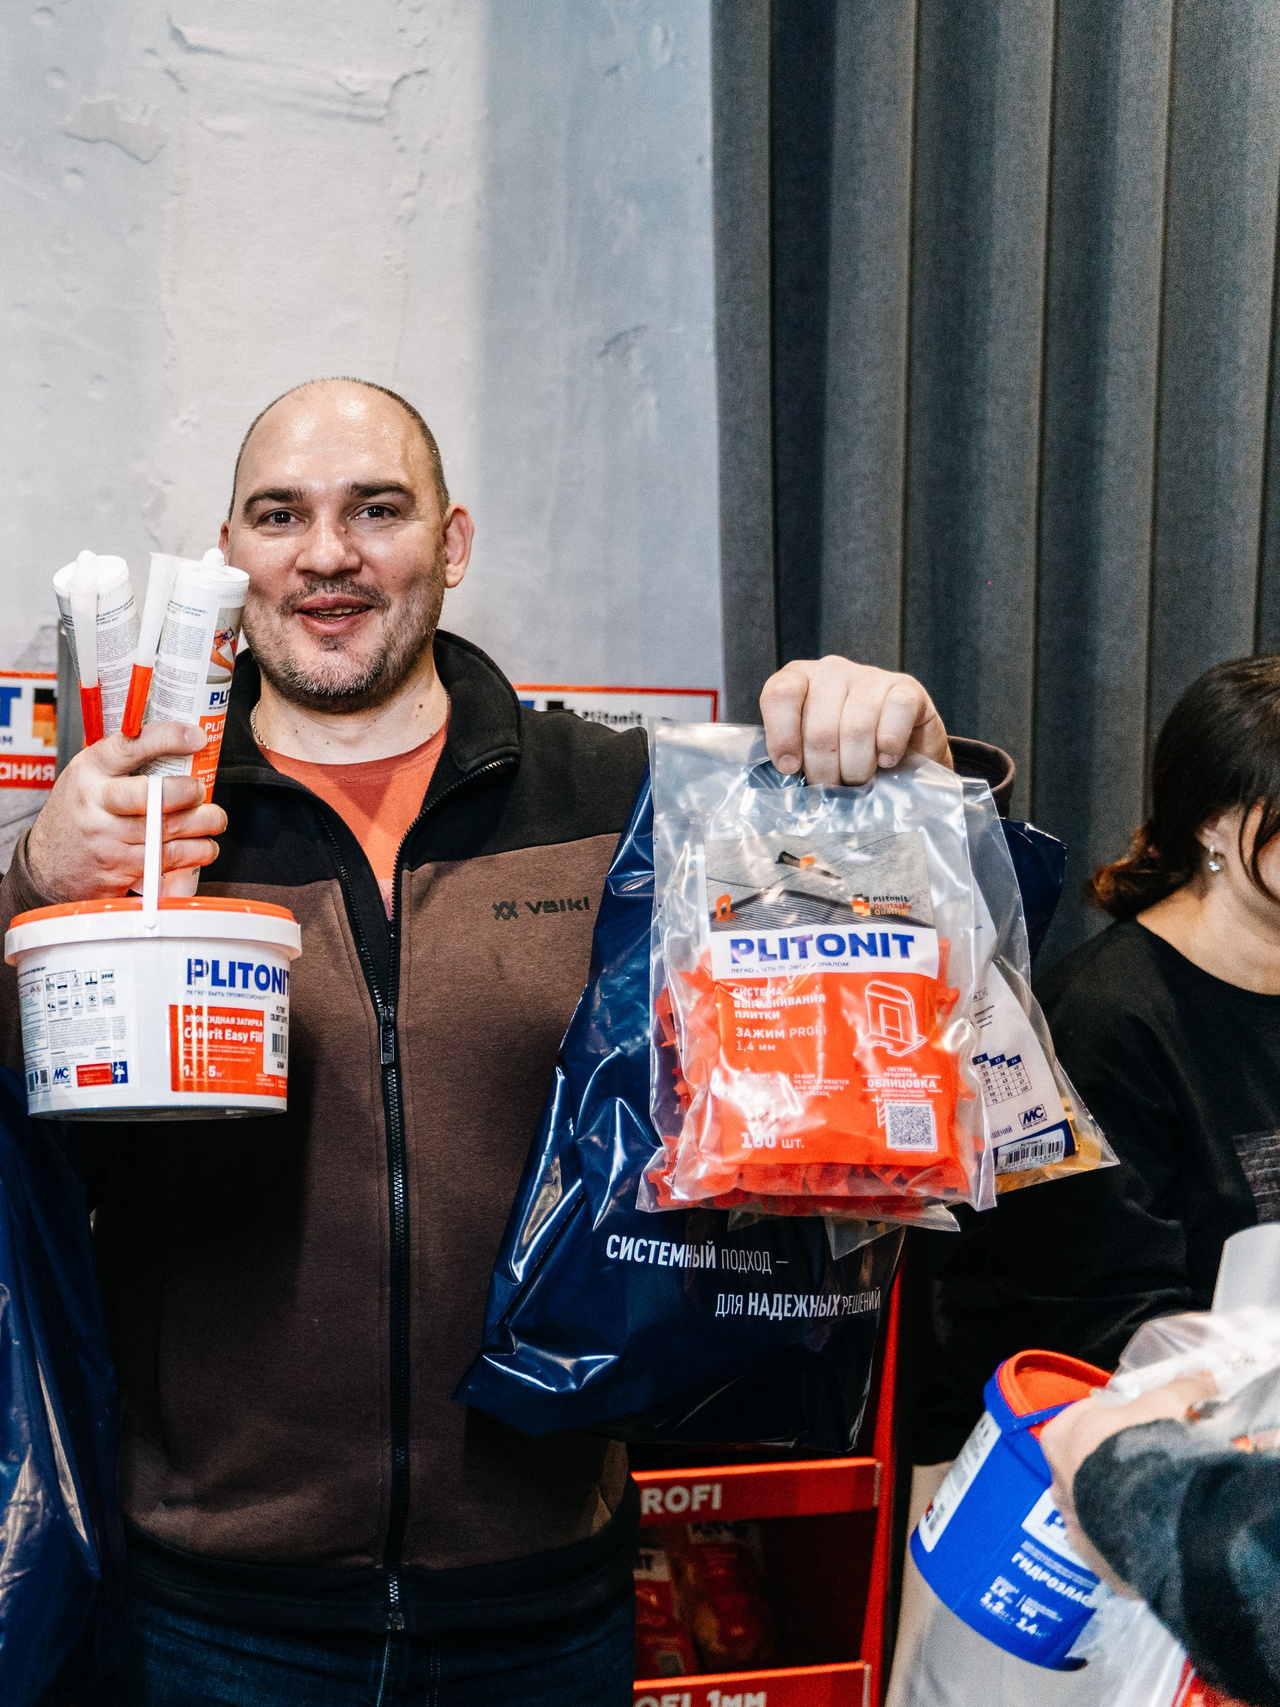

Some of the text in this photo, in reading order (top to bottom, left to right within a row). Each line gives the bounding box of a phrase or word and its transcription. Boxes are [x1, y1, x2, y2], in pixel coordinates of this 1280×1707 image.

[730, 932, 914, 965] PLITONIT
[732, 986, 784, 997] СИСТЕМА
[733, 994, 826, 1009] ВЫРАВНИВАНИЯ
[734, 1010, 780, 1020] ПЛИТКИ
[225, 1029, 248, 1044] Easy
[250, 1031, 264, 1043] Fill
[736, 1026, 827, 1038] ЗАЖИМ PROFI
[736, 1042, 755, 1052] 1,4
[867, 1078, 937, 1089] ОБЛИЦОВКА
[1023, 1107, 1044, 1125] MC
[606, 1234, 716, 1269] СИСТЕМНЫЙ
[721, 1248, 772, 1275] ПОДХОД
[715, 1286, 882, 1320] ДЛЯ НАДЕЖНЫХ РЕШЕНИЙ
